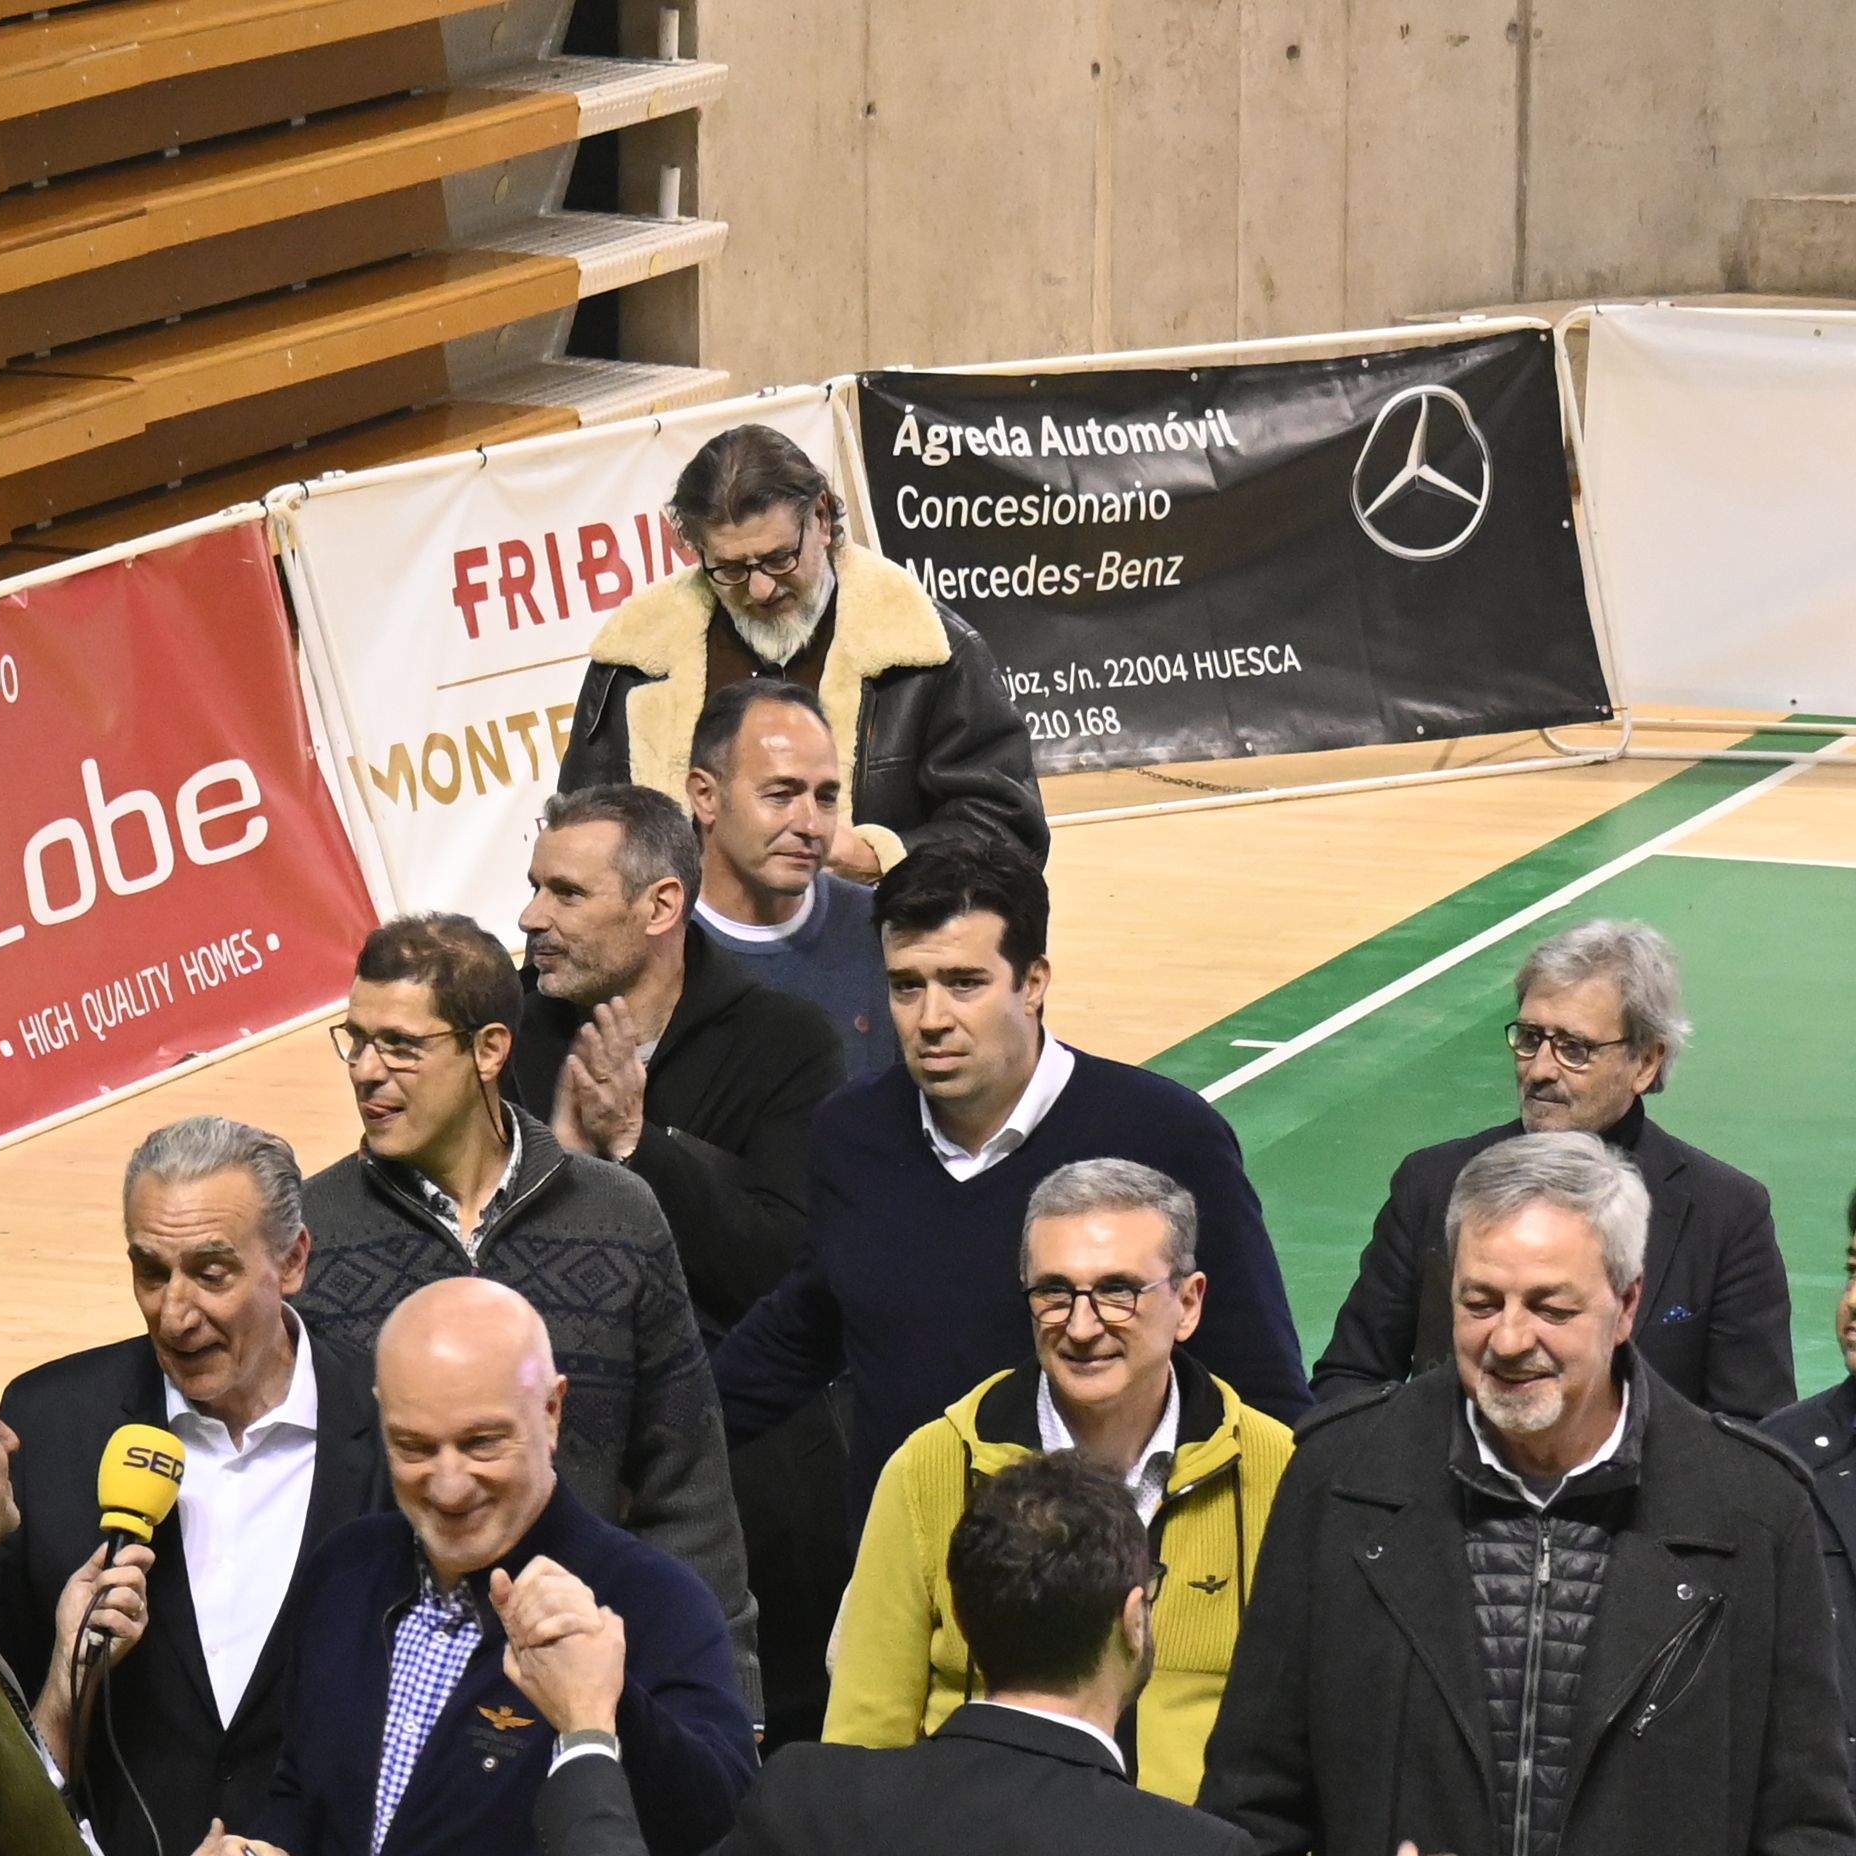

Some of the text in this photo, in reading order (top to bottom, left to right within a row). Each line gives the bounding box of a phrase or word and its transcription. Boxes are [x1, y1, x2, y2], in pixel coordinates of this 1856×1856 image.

[892, 404, 1241, 466] Ágreda Automóvil
[896, 482, 1171, 530] Concesionario
[904, 551, 1185, 600] Mercedes-Benz
[1053, 661, 1101, 692] s/n.
[1108, 654, 1188, 689] 22004
[1193, 644, 1301, 682] HUESCA
[1025, 706, 1121, 741] 210 168
[18, 928, 263, 1060] HIGH QUALITY HOMES
